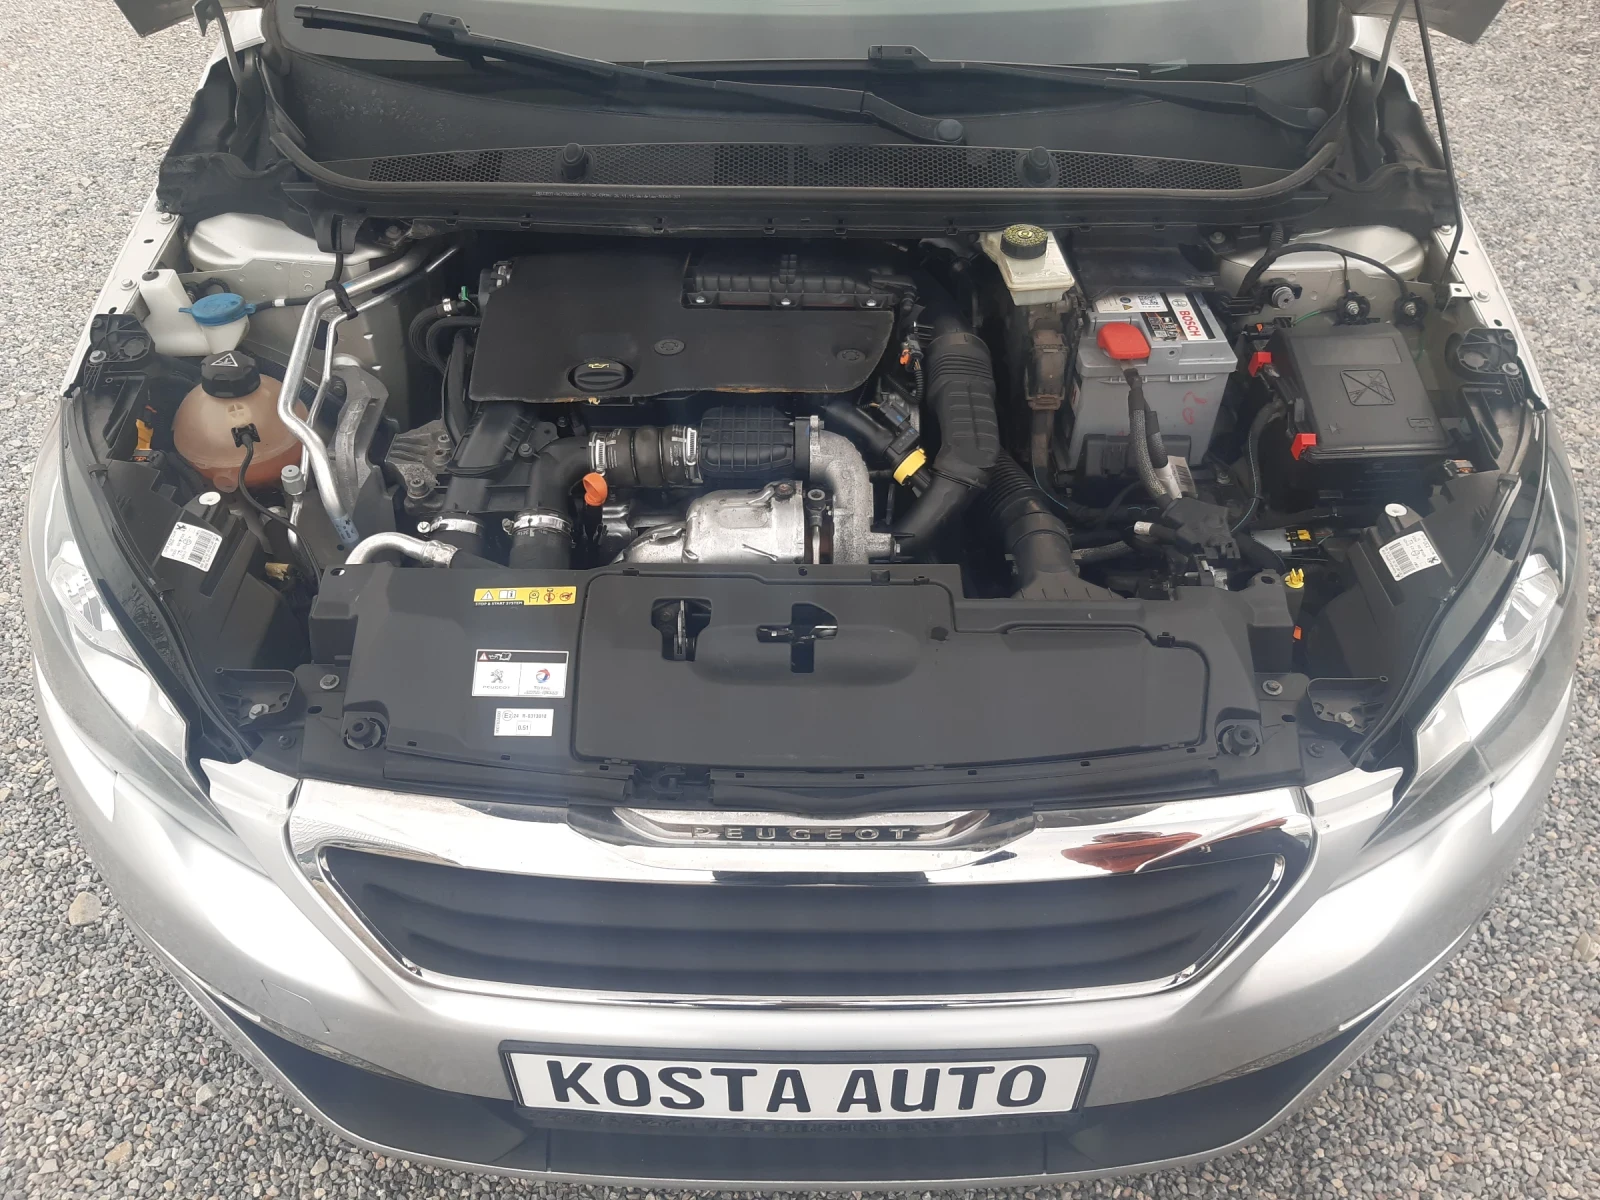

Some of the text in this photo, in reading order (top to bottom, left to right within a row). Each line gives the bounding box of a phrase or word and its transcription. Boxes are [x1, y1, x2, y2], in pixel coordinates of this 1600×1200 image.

[1179, 310, 1201, 337] BOSCH
[691, 826, 911, 841] PEUGEOT
[546, 1060, 1047, 1113] KOSTA AUTO
